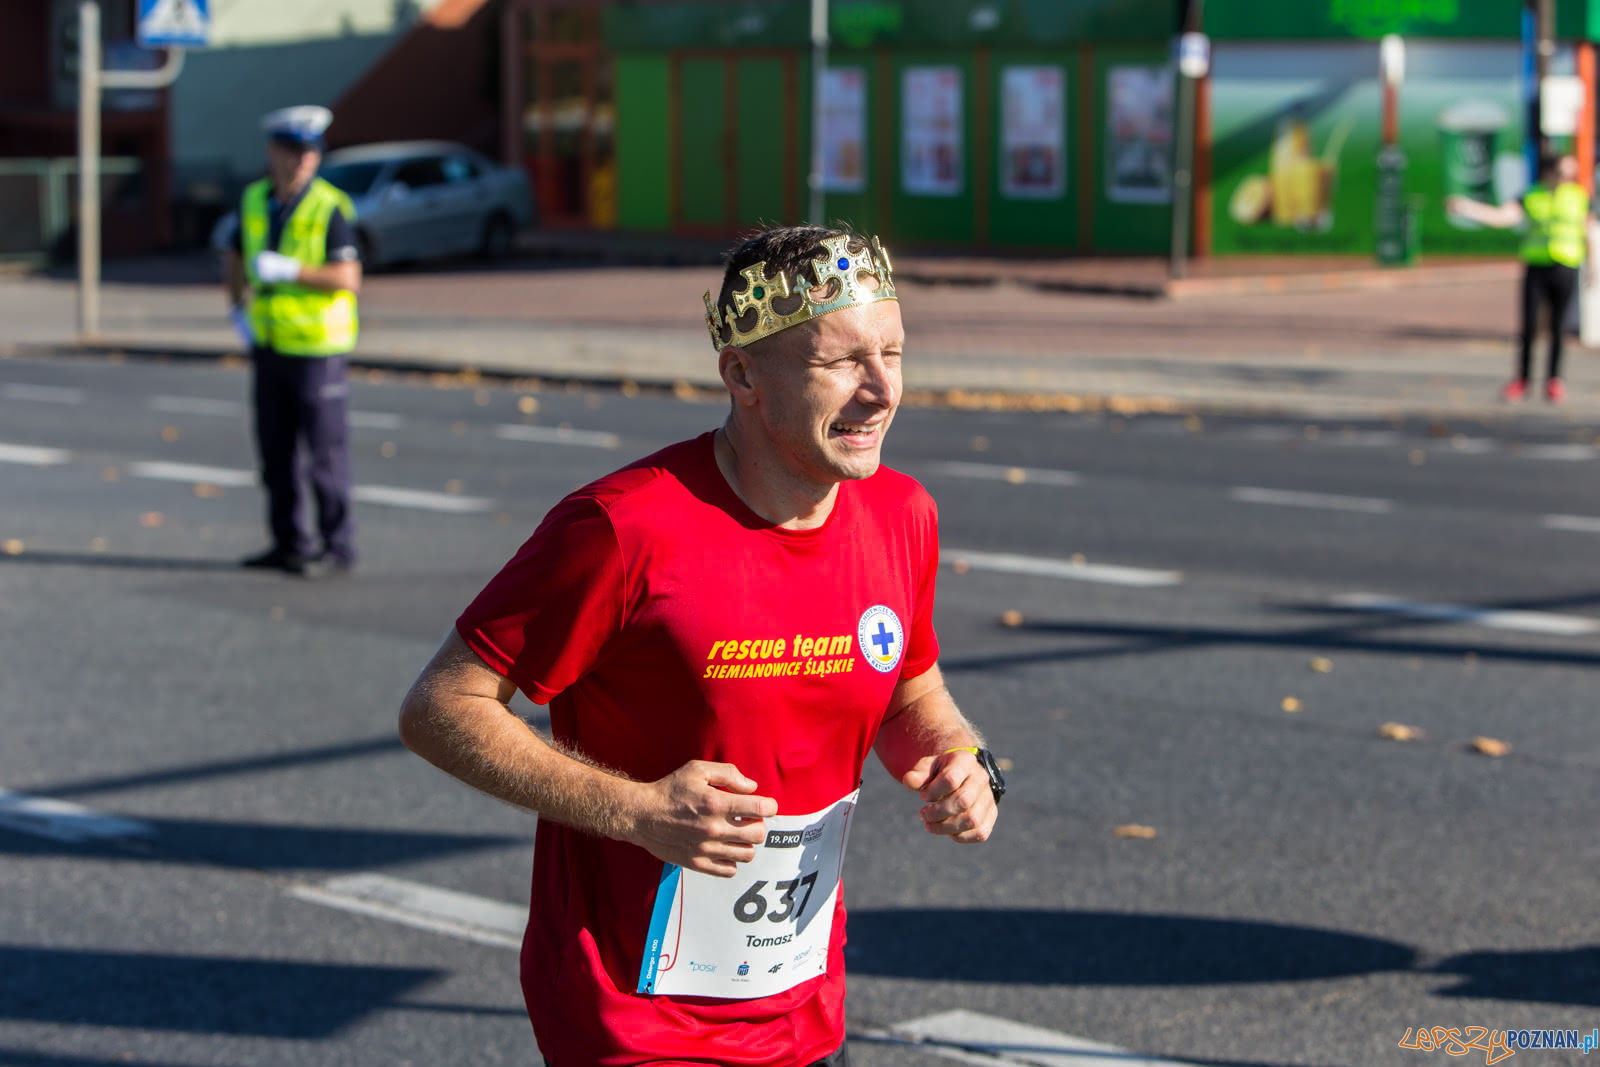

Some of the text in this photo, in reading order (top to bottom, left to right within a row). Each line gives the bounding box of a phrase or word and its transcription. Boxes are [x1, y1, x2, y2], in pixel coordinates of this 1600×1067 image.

[707, 634, 853, 660] rescue team
[703, 657, 855, 679] SIEMIANOWICE ŚLĄSKIE
[782, 834, 801, 844] PKO
[733, 870, 819, 924] 637
[746, 933, 793, 948] Tomasz
